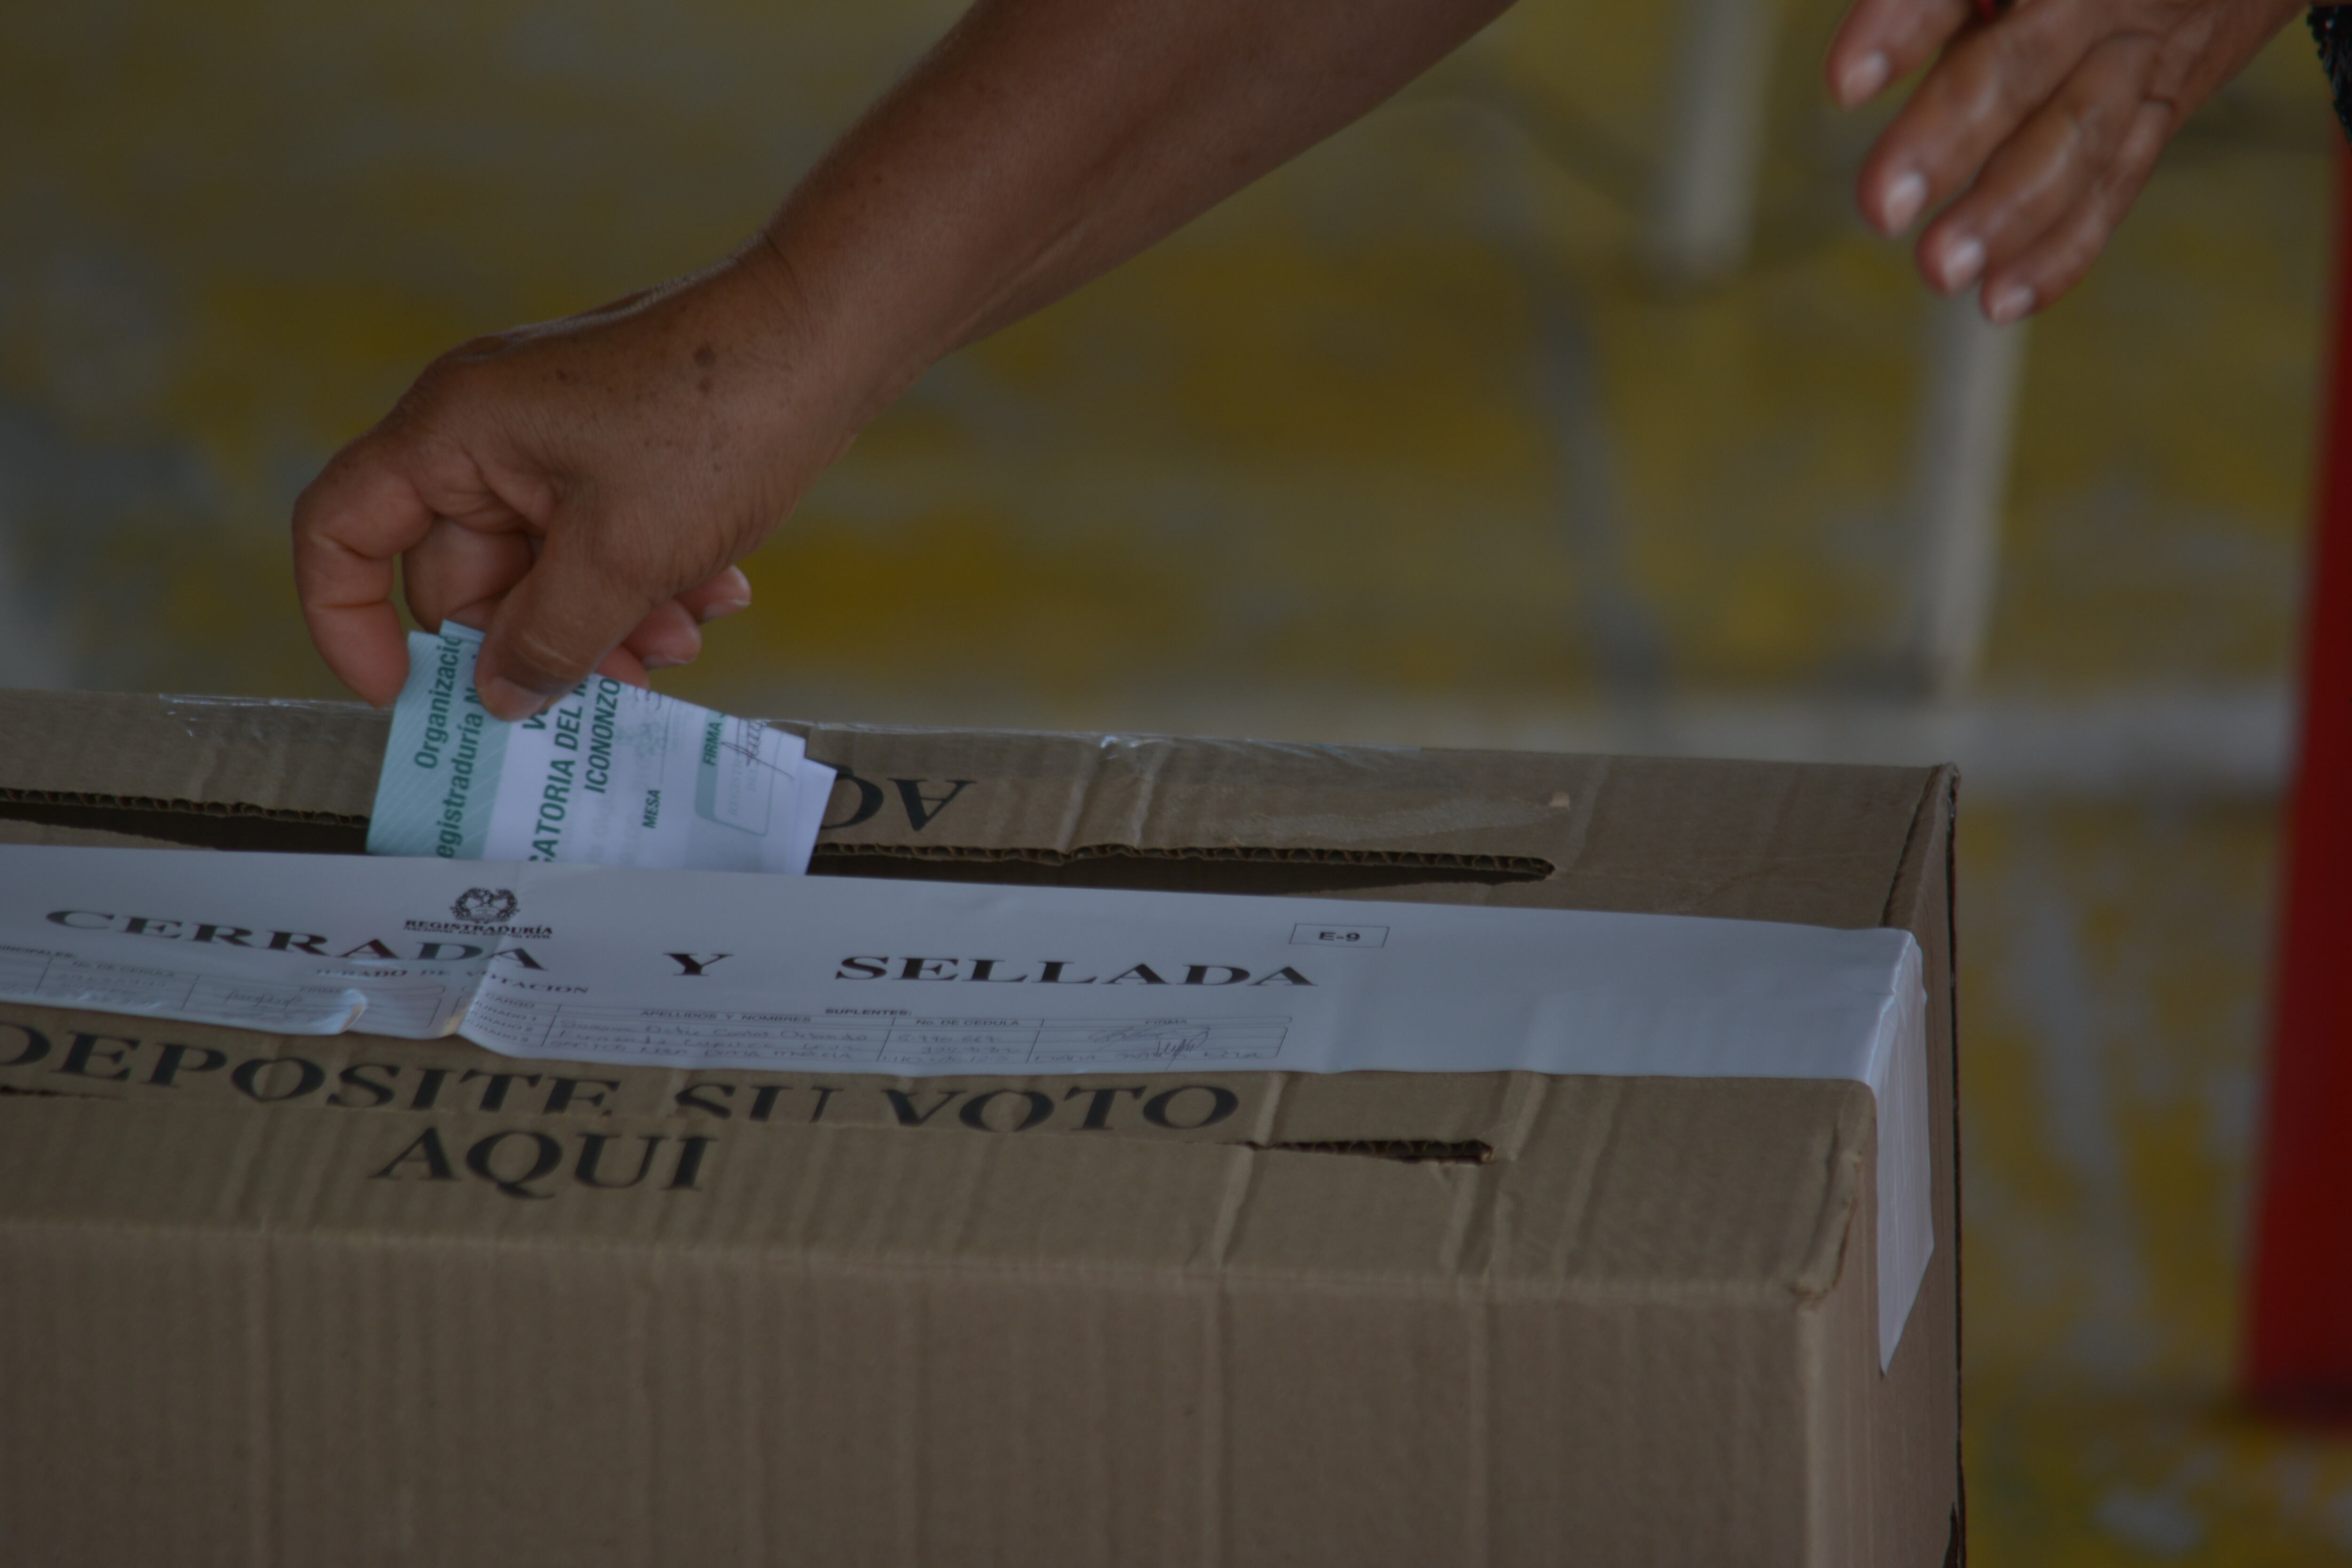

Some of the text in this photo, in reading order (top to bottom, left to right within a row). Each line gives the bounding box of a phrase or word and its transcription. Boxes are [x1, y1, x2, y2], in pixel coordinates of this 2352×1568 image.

[555, 706, 582, 752] DEL
[584, 677, 620, 794] ICONONZO
[702, 721, 723, 767] FIRMA
[641, 788, 662, 829] MESA
[46, 910, 1318, 986] CERRADA Y SELLADA
[405, 920, 554, 934] REGISTRADURÍA
[1318, 931, 1361, 942] E-9
[640, 1010, 717, 1020] APELLIDOS
[741, 1013, 811, 1023] NOMBRES
[825, 1008, 912, 1016] SUPLENTES:
[881, 1085, 1240, 1132] VOTO
[368, 1125, 718, 1201] AQUI
